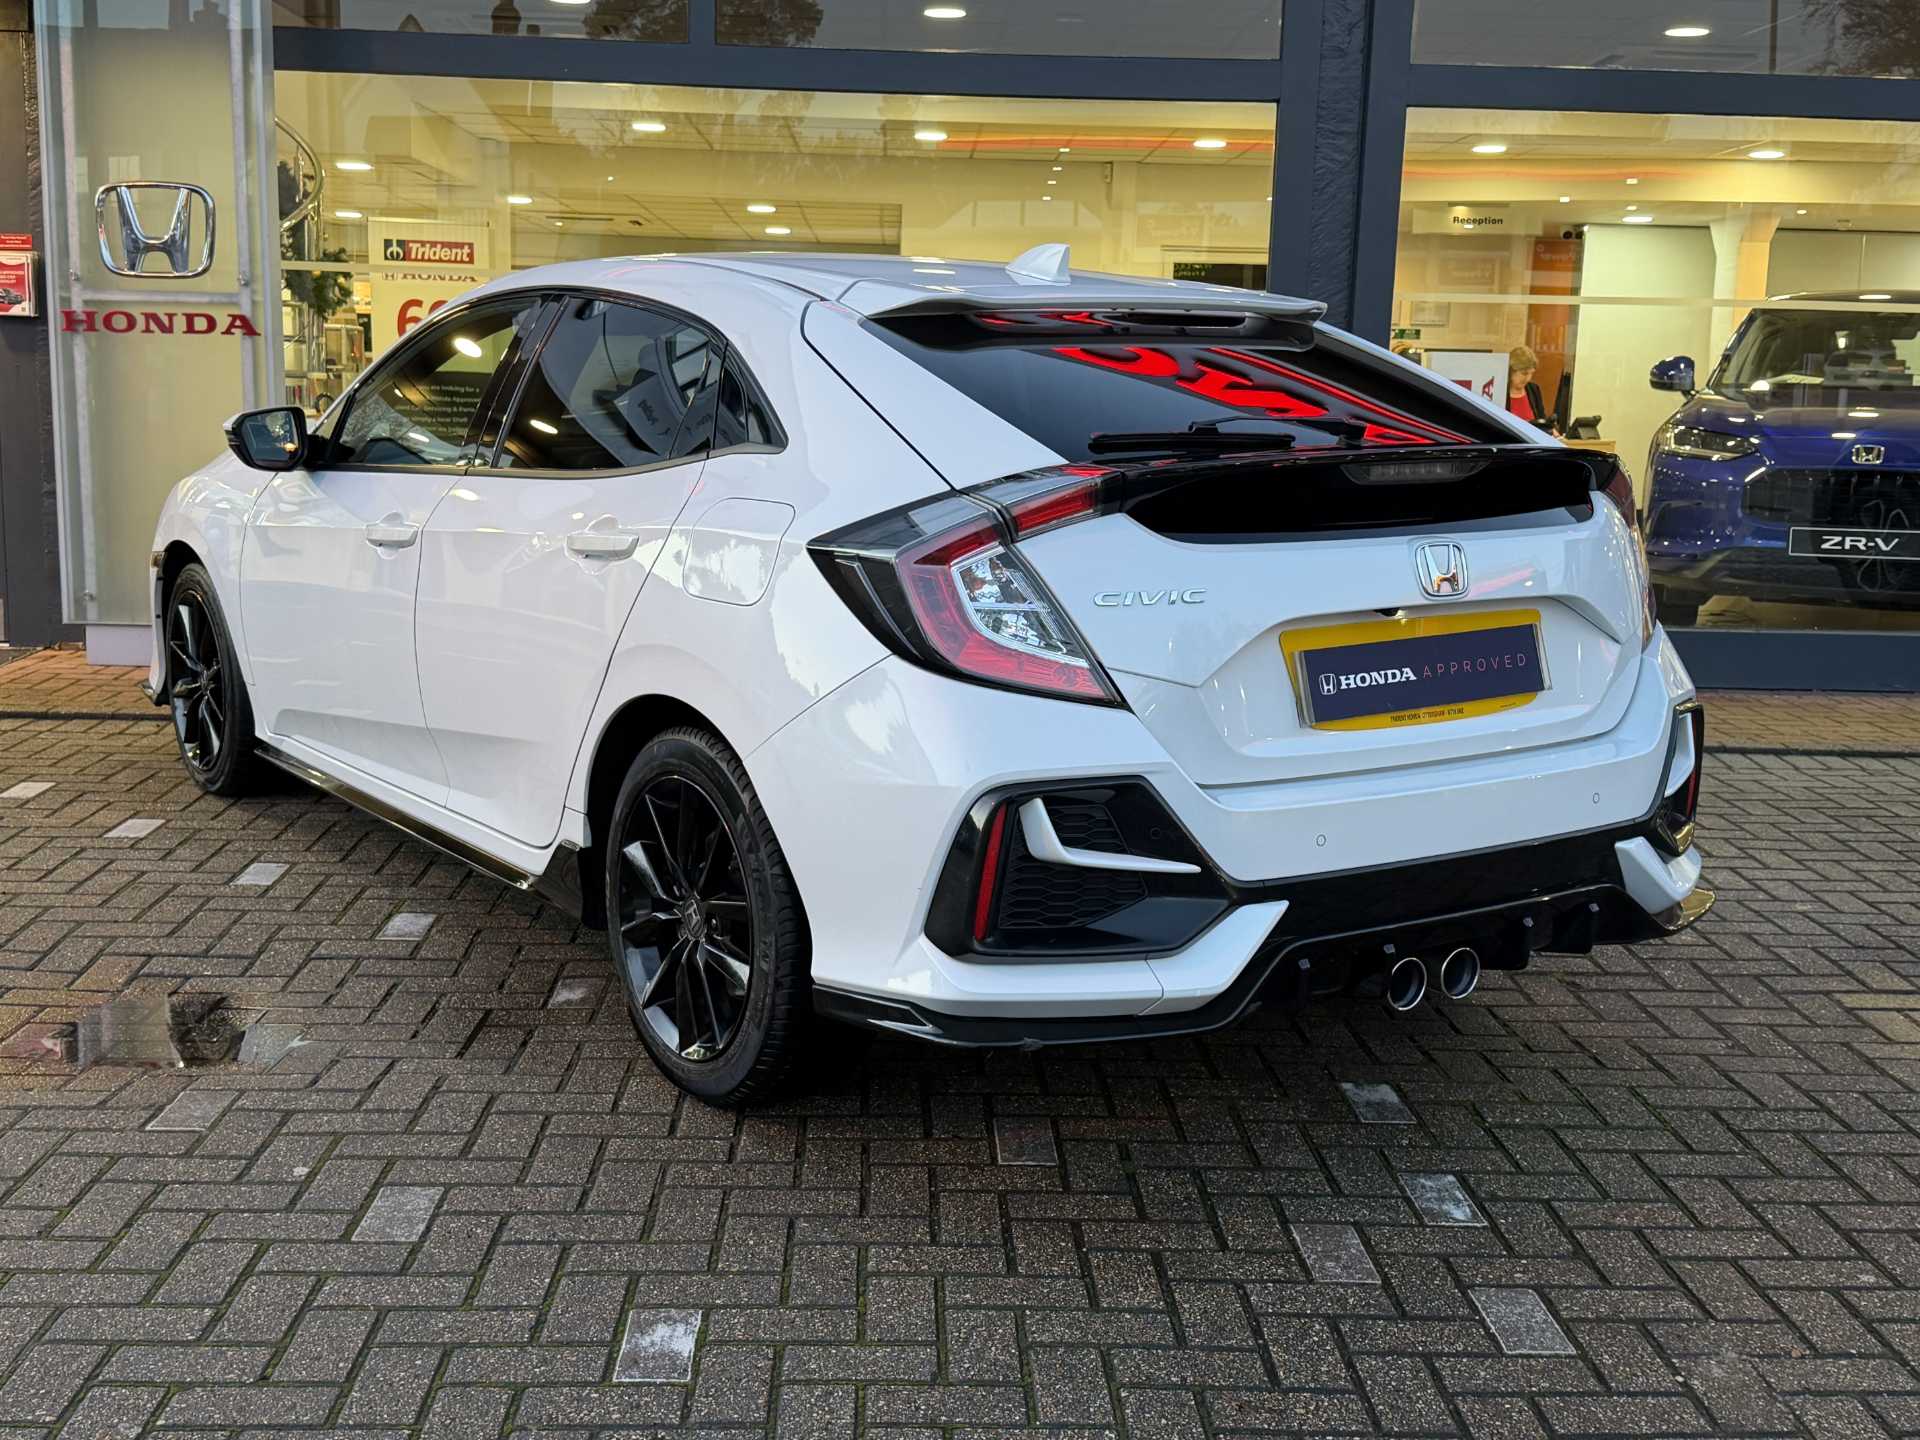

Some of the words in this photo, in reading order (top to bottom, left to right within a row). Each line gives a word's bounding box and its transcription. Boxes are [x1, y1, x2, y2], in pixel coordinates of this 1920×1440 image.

[1453, 216, 1504, 226] Reception
[409, 242, 471, 262] Trident
[60, 310, 262, 336] HONDA
[1820, 535, 1899, 551] ZR-V
[1093, 588, 1207, 606] CIVIC
[1339, 667, 1417, 690] HONDA
[1423, 653, 1526, 678] APPROVED
